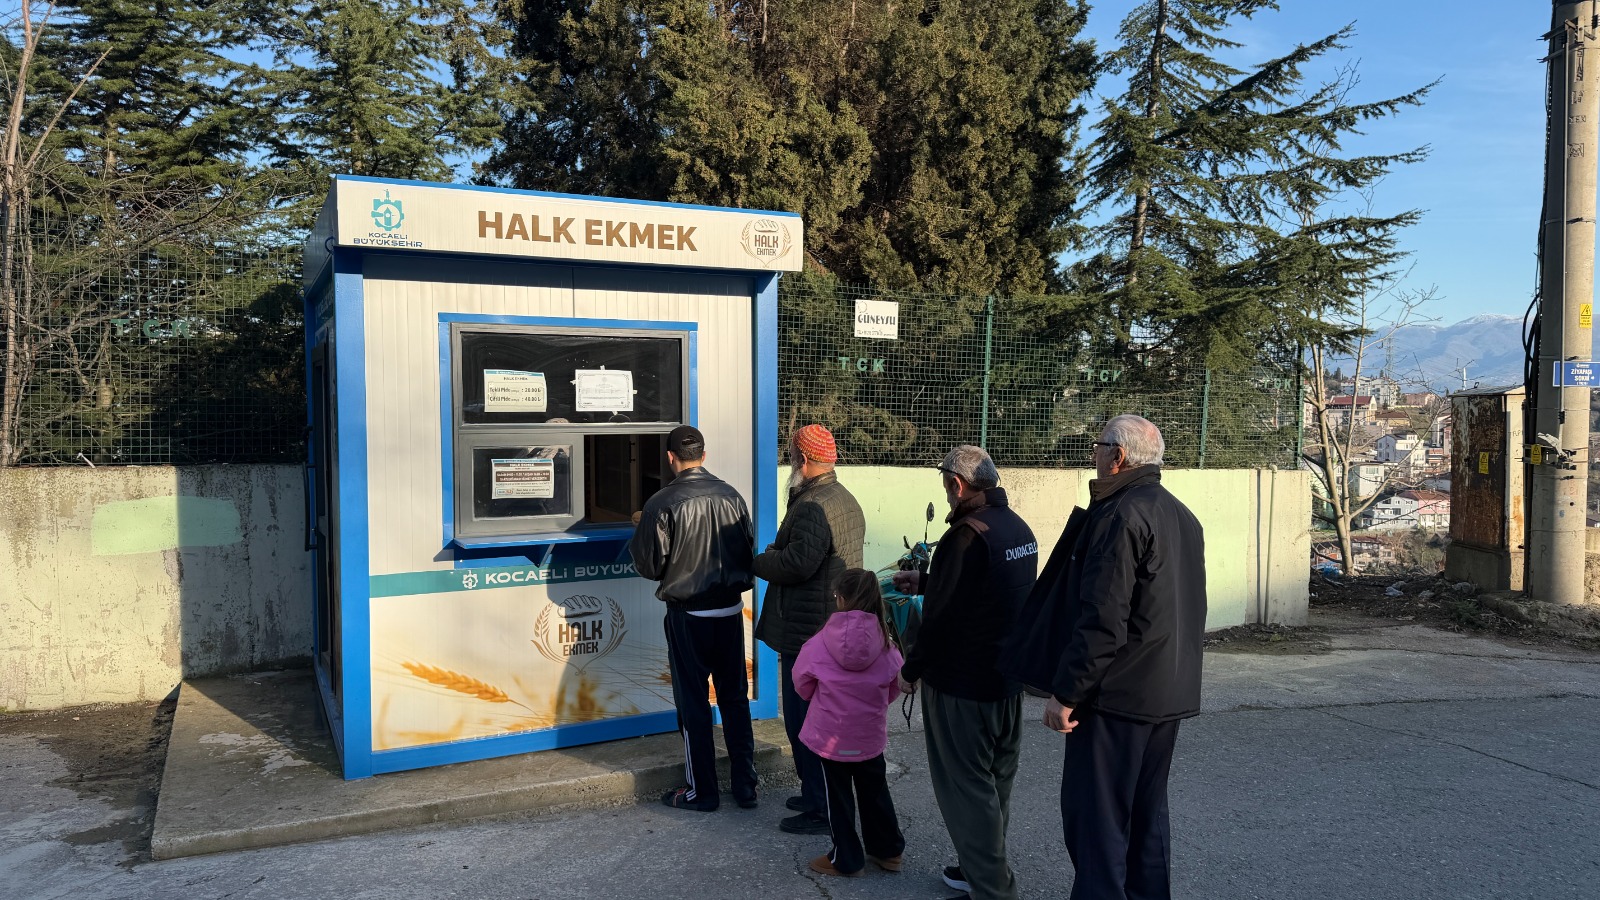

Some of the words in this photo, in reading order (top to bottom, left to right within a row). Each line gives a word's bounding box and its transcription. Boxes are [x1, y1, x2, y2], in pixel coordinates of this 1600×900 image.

[478, 210, 577, 245] HALK
[585, 218, 699, 252] EKMEK
[754, 234, 779, 249] HALK
[756, 247, 777, 256] EKMEK
[858, 313, 896, 325] GÜNEYSU
[838, 356, 885, 372] TCK
[574, 563, 636, 578] BÜYÜK
[558, 620, 603, 644] HALK
[563, 642, 599, 657] EKMEK
